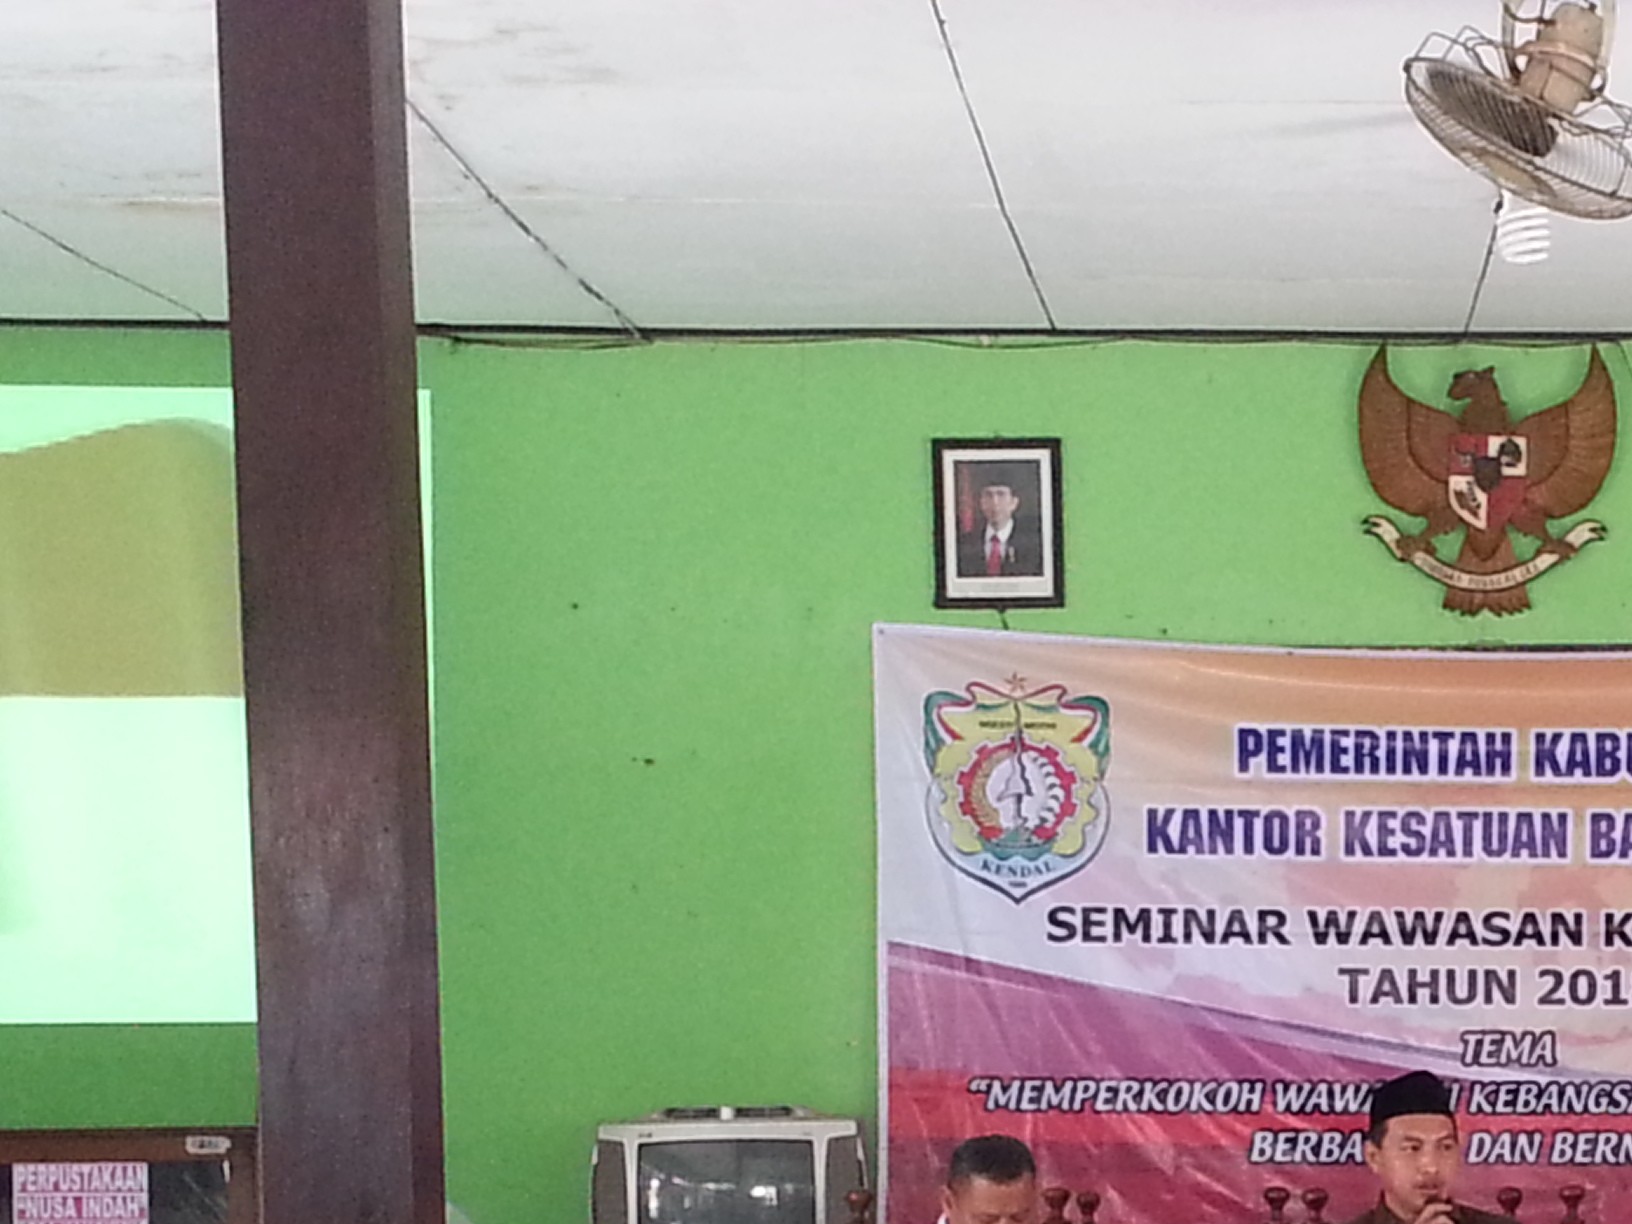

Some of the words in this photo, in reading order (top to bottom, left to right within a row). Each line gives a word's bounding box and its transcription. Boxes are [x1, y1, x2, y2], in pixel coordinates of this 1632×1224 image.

[1236, 728, 1512, 777] PEMERINTAH
[1146, 807, 1322, 857] KANTOR
[1344, 810, 1568, 860] KESATUAN
[981, 856, 1054, 876] KENDAL
[1047, 906, 1292, 946] SEMINAR
[1307, 909, 1583, 948] WAWASAN
[1339, 967, 1517, 1007] TAHUN
[1462, 1032, 1557, 1066] TEMA
[1251, 1131, 1364, 1164] BERBA
[1467, 1132, 1542, 1164] DAN
[17, 1166, 145, 1191] PERPUSTAKAAN
